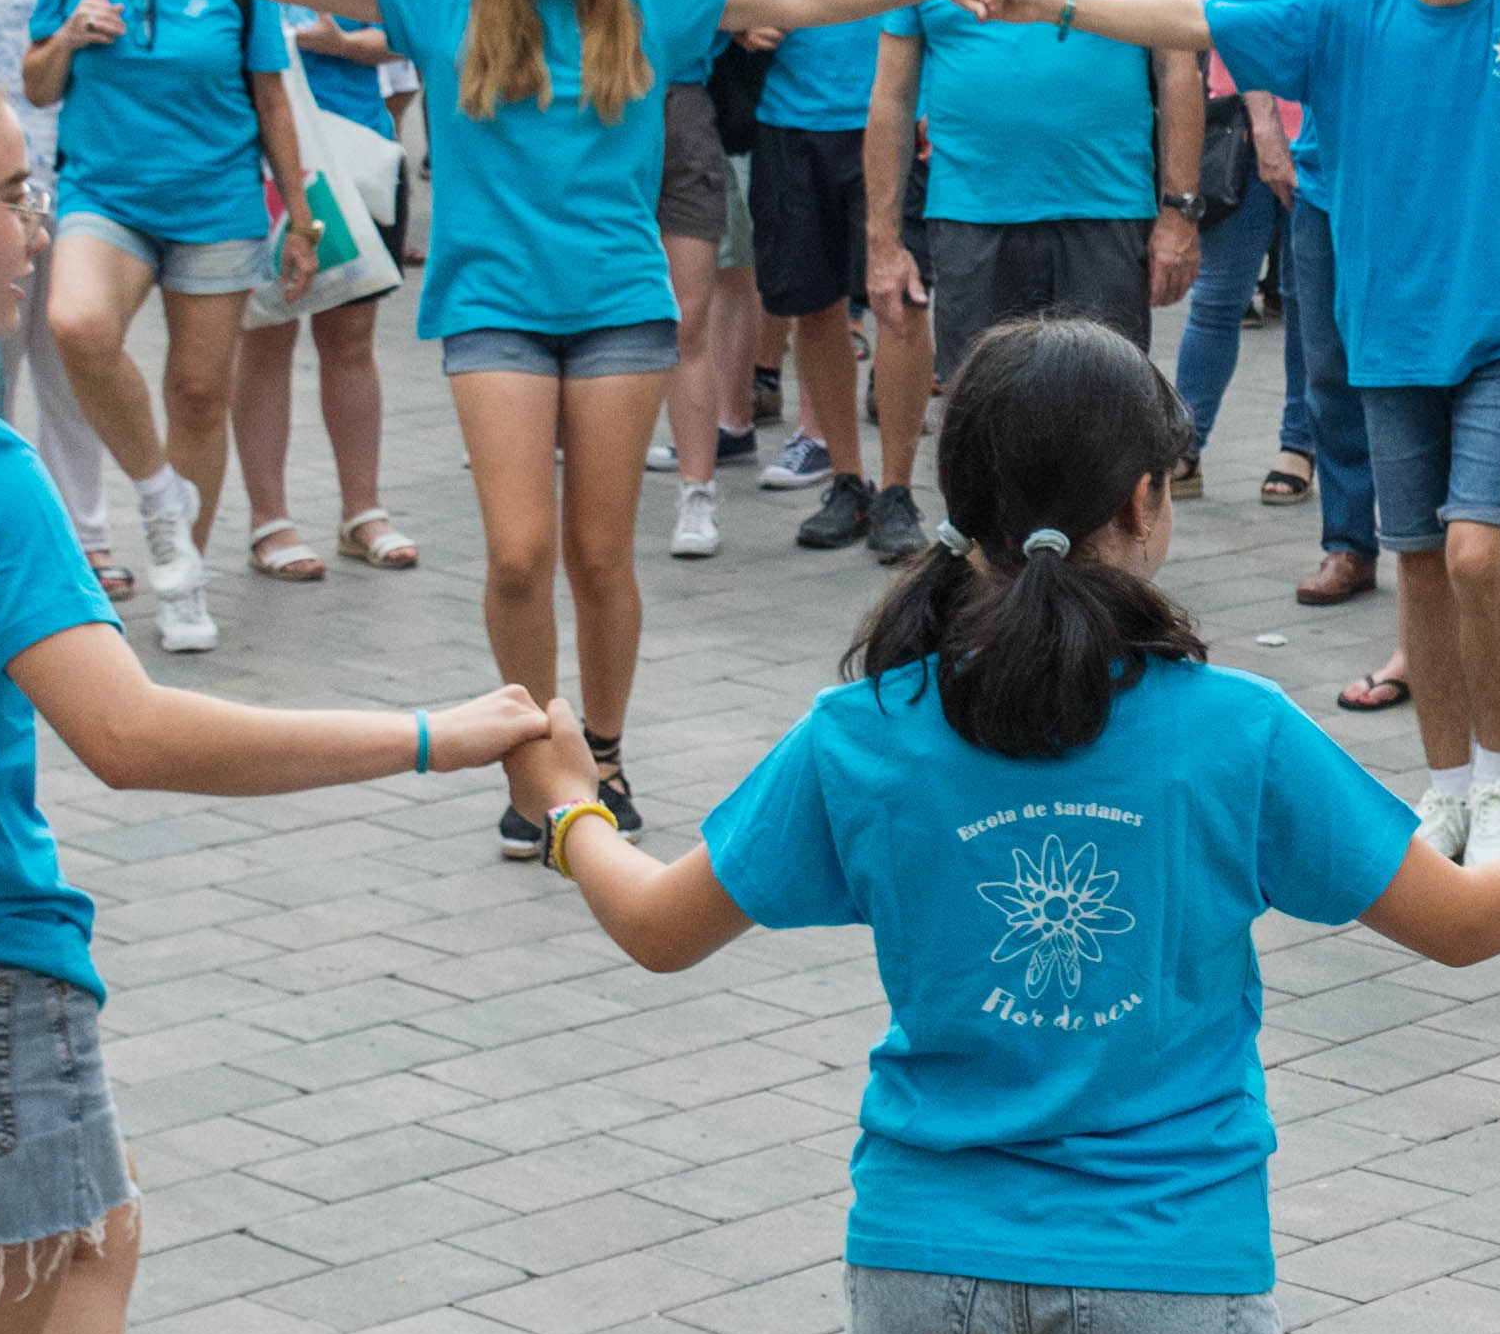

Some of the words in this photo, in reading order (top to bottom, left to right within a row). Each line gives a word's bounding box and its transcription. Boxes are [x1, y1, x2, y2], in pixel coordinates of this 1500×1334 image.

[956, 807, 1018, 843] Escola
[1022, 803, 1048, 820] de
[981, 986, 1048, 1028] Flor
[1053, 1003, 1088, 1032] de
[1093, 992, 1145, 1028] neu
